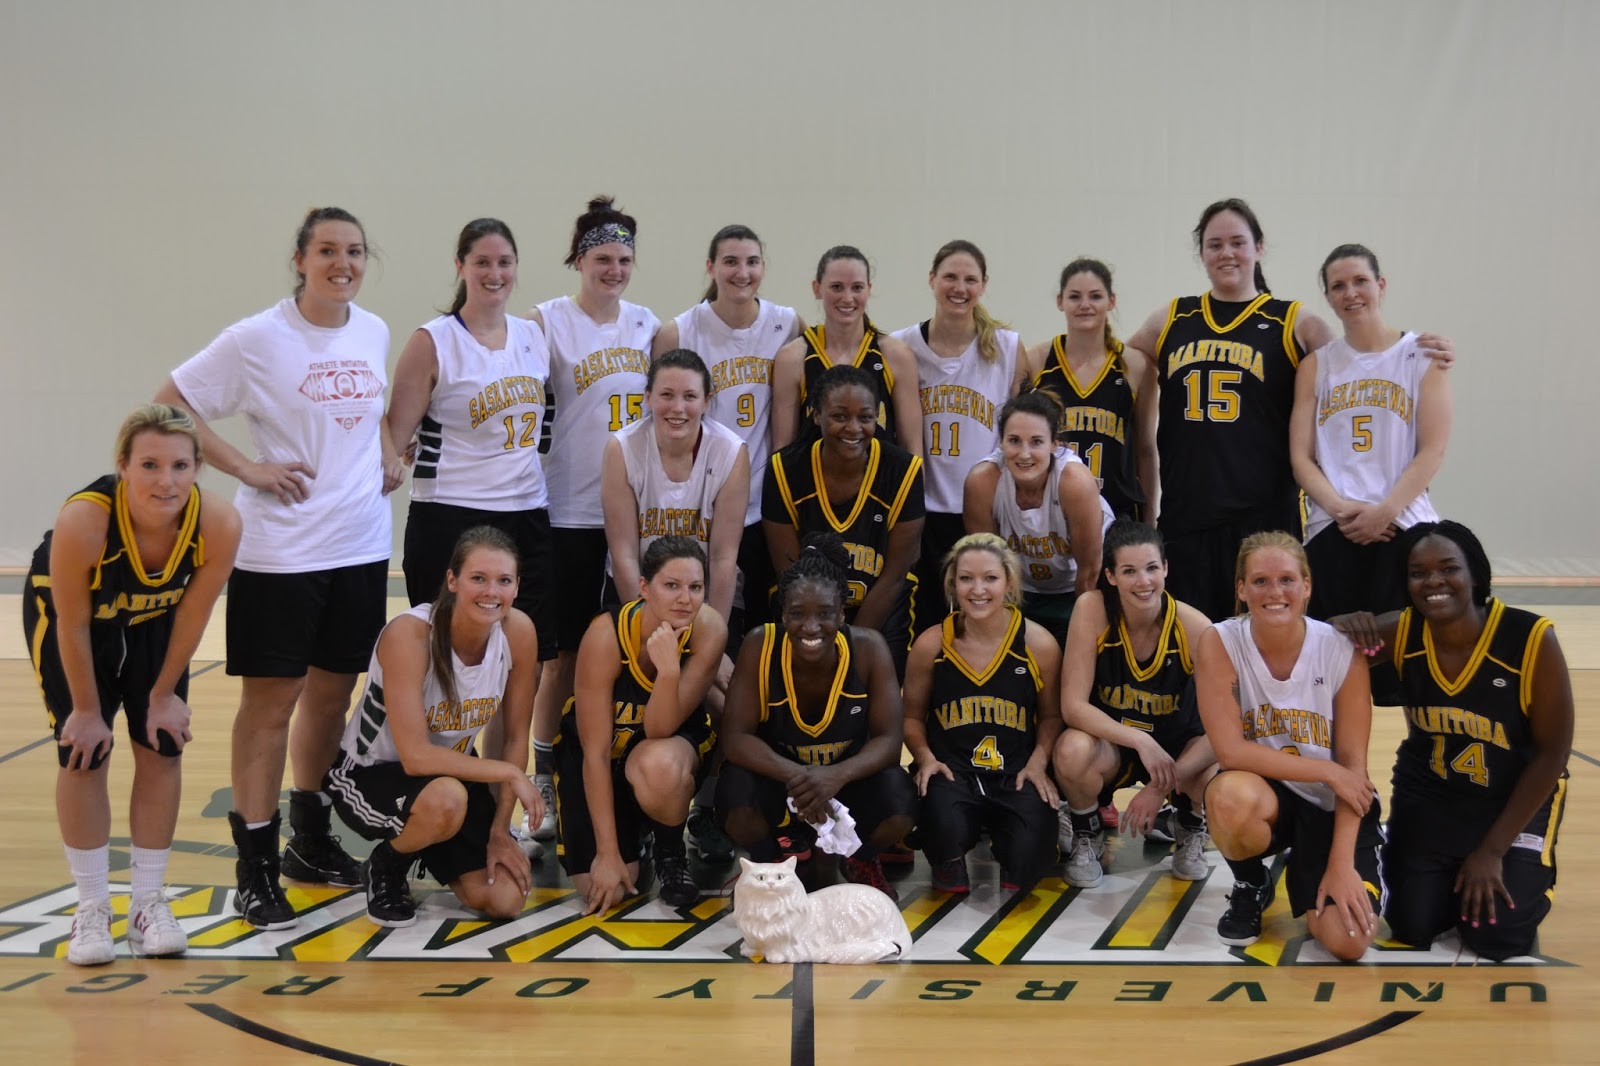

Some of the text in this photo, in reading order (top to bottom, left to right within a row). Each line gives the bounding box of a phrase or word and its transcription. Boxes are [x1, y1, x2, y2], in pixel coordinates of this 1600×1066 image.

[1167, 339, 1264, 382] MANITOBA
[608, 393, 644, 431] 15
[736, 393, 755, 427] 9
[919, 384, 995, 433] KATCHEWAN
[1183, 370, 1242, 422] 15
[503, 411, 536, 450] 12
[930, 421, 960, 456] 11
[1057, 405, 1125, 445] NITOBA
[1352, 415, 1373, 452] 5
[934, 695, 1027, 733] MANITOBA
[971, 735, 1004, 771] 4
[1429, 734, 1489, 788] 14
[420, 976, 590, 998] OF
